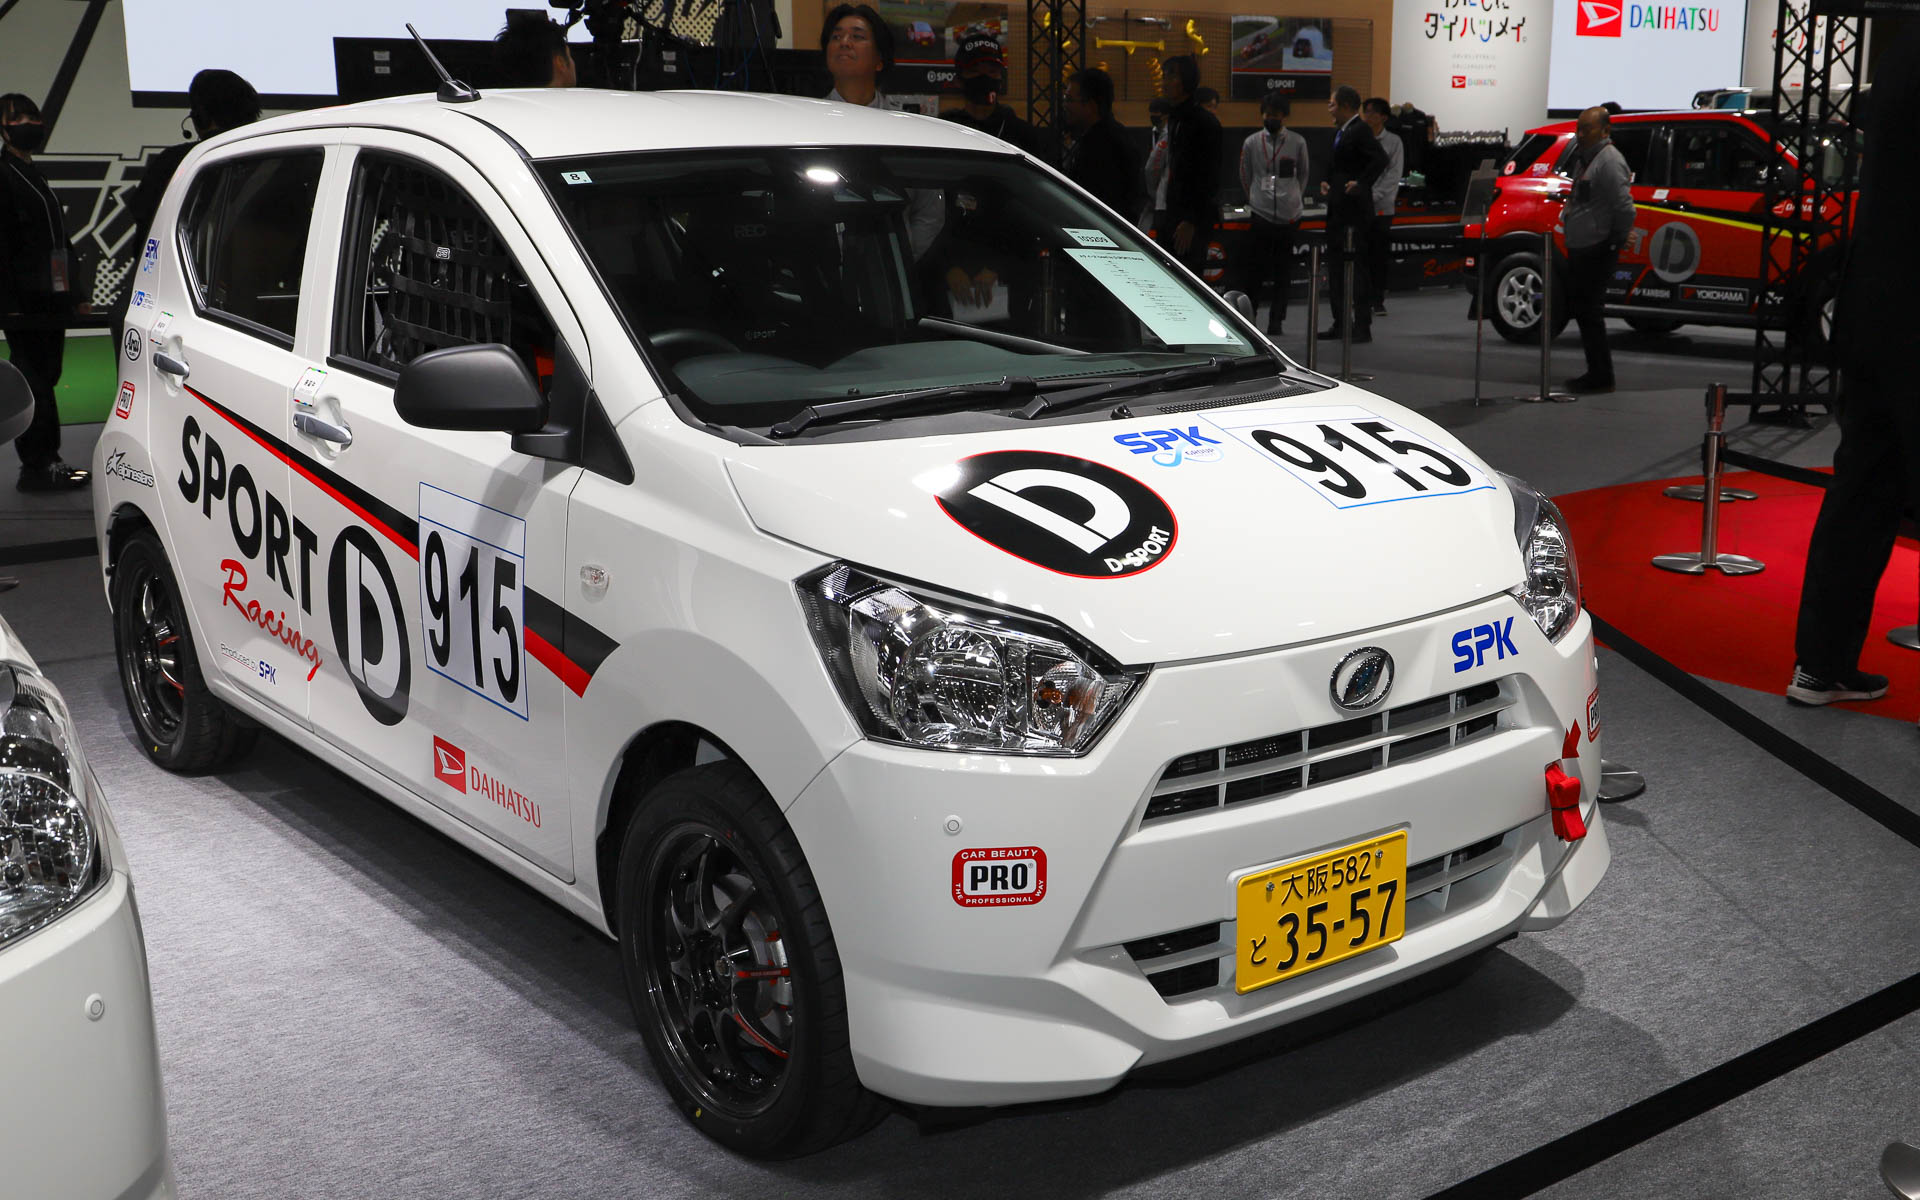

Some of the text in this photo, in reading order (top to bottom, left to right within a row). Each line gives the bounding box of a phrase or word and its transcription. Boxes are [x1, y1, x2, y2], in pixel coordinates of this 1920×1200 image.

[1630, 4, 1719, 31] DAIHATSU
[974, 40, 999, 51] SPORT
[1274, 80, 1296, 88] SPORT
[1695, 290, 1745, 302] YOKOHAMA
[1113, 426, 1223, 455] SPK
[118, 462, 154, 487] alpinestars
[1251, 422, 1472, 499] 915
[177, 415, 318, 616] SPORT
[1106, 526, 1170, 574] D-SPORT
[220, 558, 323, 682] Racing
[424, 530, 520, 704] 915
[1451, 616, 1520, 674] SPK
[259, 660, 276, 685] SPK
[471, 765, 541, 828] DAIHATSU
[961, 848, 1038, 860] CAR BEAUTY
[955, 879, 1044, 905] THE PROFESSIONAL WAY
[1251, 878, 1398, 971] と 35-57
